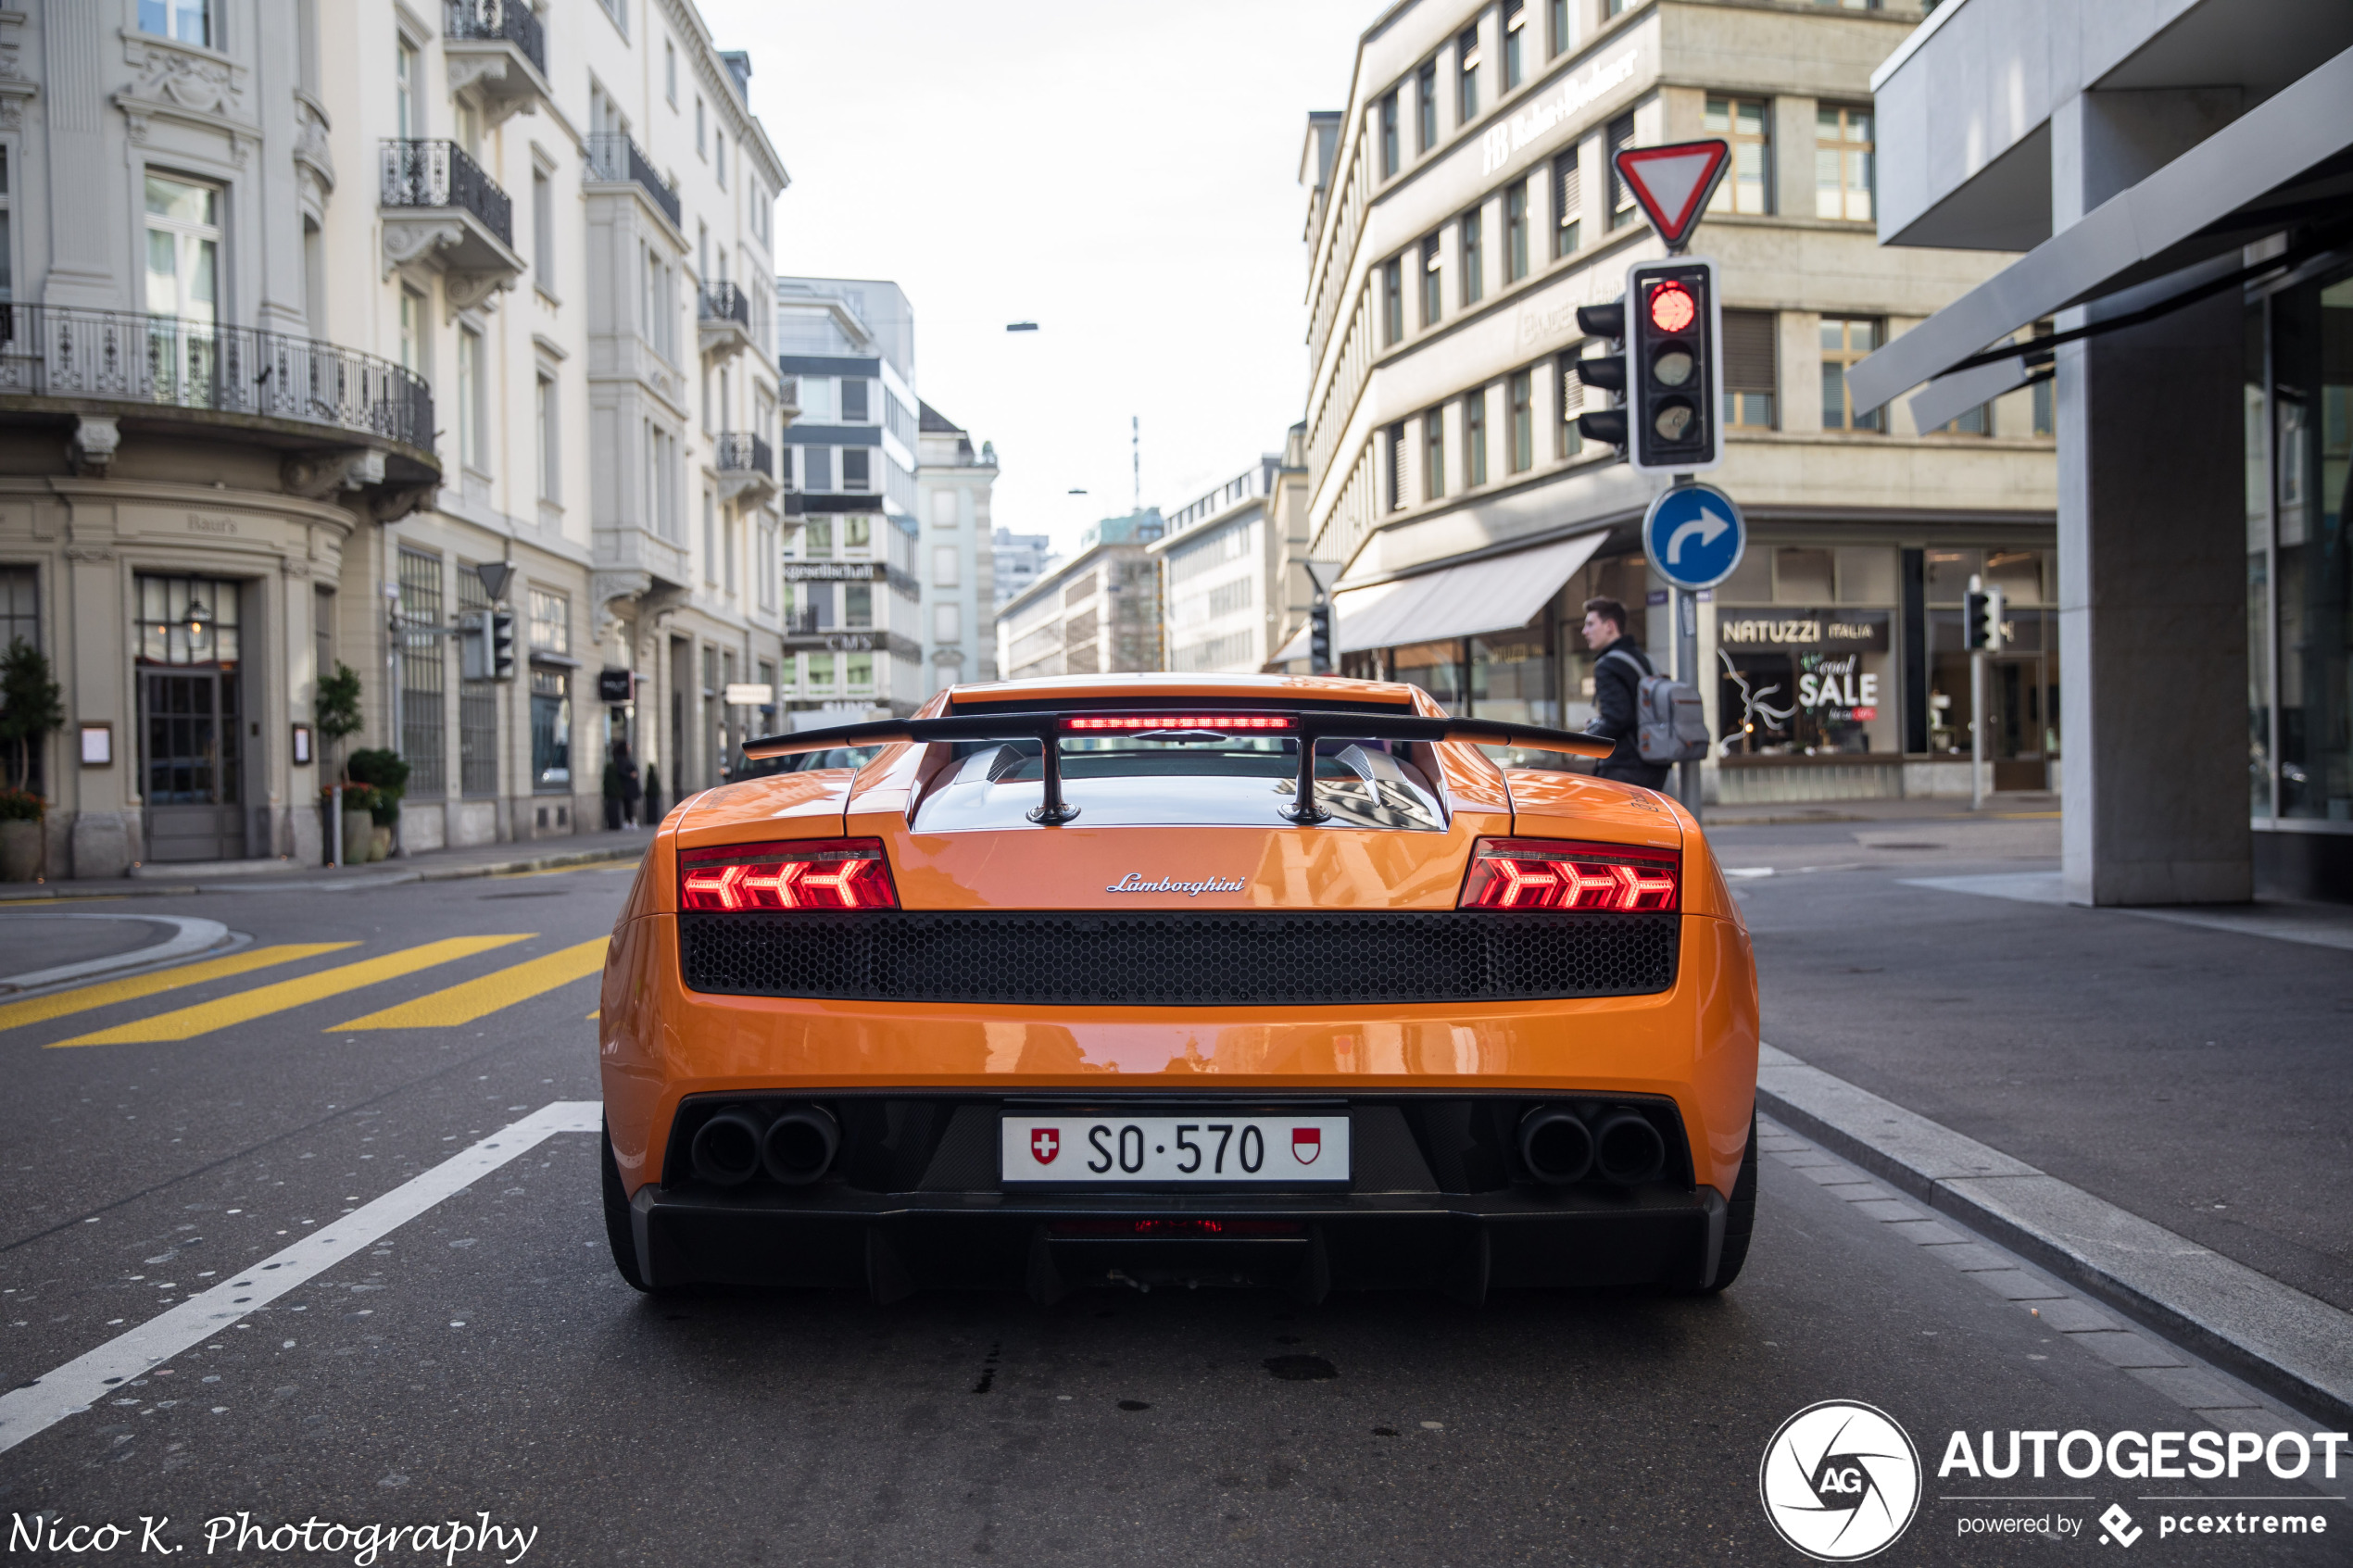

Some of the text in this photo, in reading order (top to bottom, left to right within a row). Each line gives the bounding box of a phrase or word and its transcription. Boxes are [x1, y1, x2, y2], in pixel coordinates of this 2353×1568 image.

[1722, 620, 1873, 643] NATUZZI ITALIA
[1798, 672, 1879, 707] SALE
[1105, 872, 1246, 897] Lamborghini
